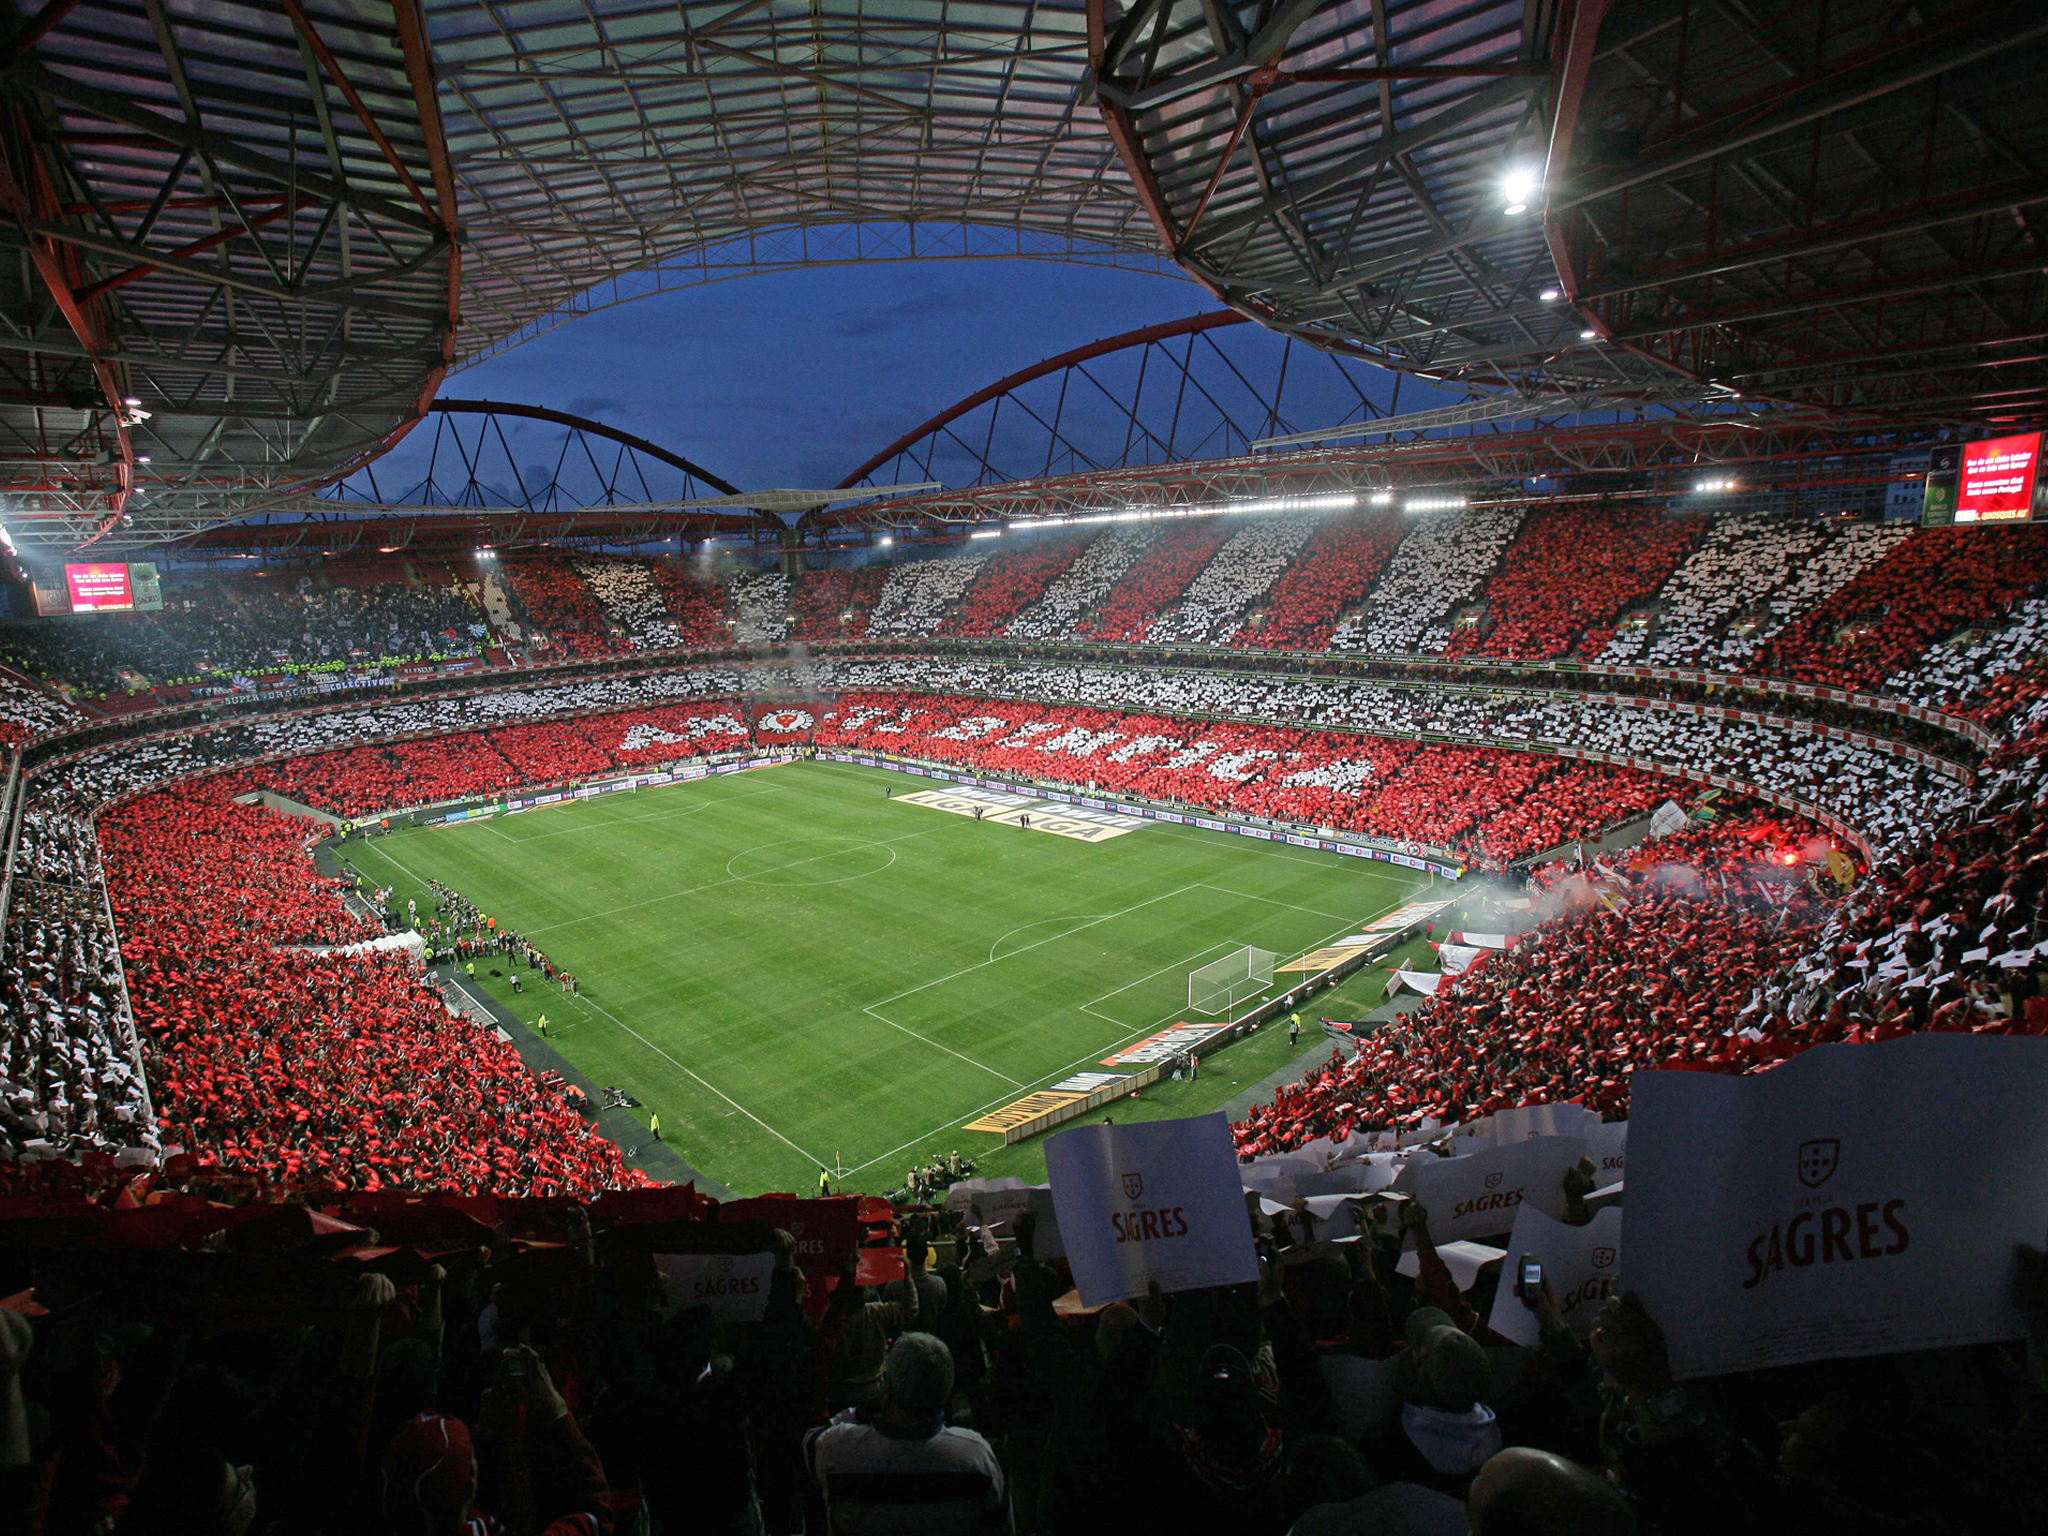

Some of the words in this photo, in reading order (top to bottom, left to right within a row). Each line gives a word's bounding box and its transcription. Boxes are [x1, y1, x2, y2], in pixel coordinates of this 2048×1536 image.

[224, 693, 260, 706] SUPER
[911, 794, 992, 816] LIGA
[939, 786, 1031, 806] bwin
[484, 805, 500, 813] BES
[1036, 803, 1143, 829] bwin
[1004, 814, 1104, 839] LIGA
[992, 1202, 1026, 1213] SAGRES
[1452, 1187, 1524, 1220] SAGRES
[1111, 1206, 1189, 1243] SAGRES
[1742, 1198, 1910, 1290] SAGRES
[694, 1276, 760, 1299] SAGRES
